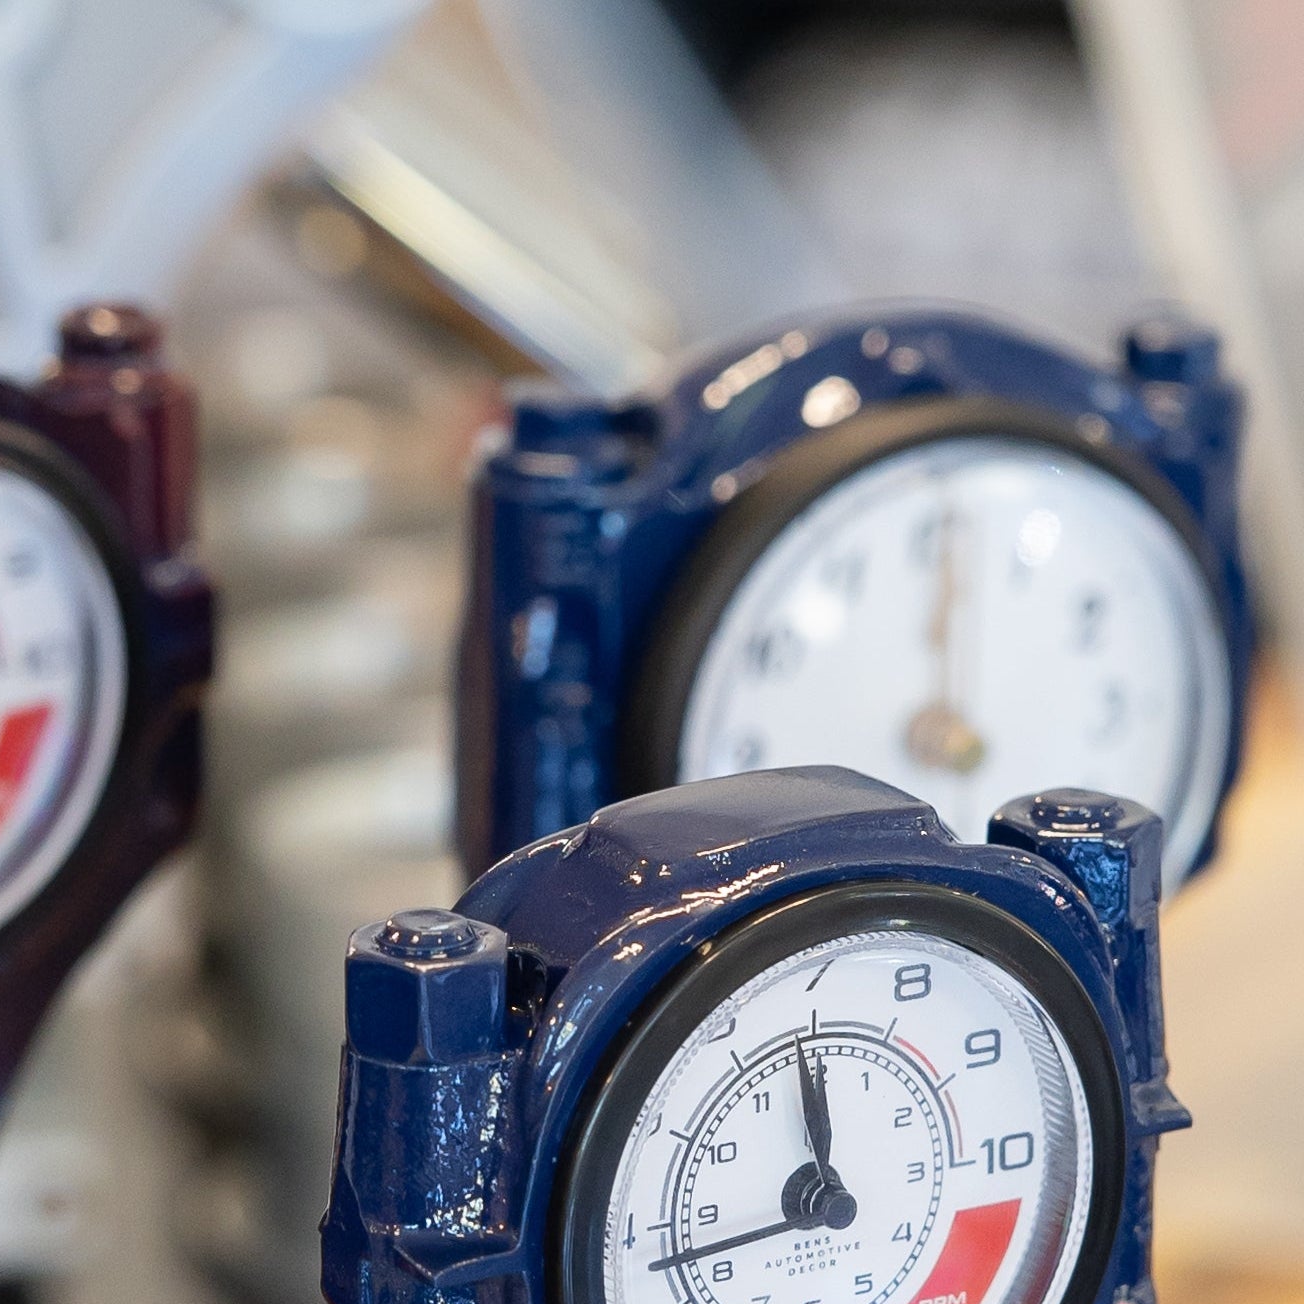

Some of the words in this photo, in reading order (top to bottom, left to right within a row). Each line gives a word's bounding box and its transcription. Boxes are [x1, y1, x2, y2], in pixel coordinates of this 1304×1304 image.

[893, 962, 933, 1002] 8
[964, 1028, 1002, 1070] 9
[860, 1071, 871, 1092] 1
[752, 1091, 771, 1114] 11
[893, 1106, 913, 1129] 2
[707, 1141, 738, 1166] 10
[979, 1131, 1035, 1175] 10
[906, 1162, 926, 1184] 3
[697, 1204, 719, 1226] 9
[793, 1235, 832, 1252] BENS
[891, 1222, 913, 1243] 4
[764, 1241, 861, 1270] AUTOMOTIVE
[712, 1260, 734, 1283] 8
[788, 1259, 837, 1277] DECOR
[853, 1272, 874, 1296] 5
